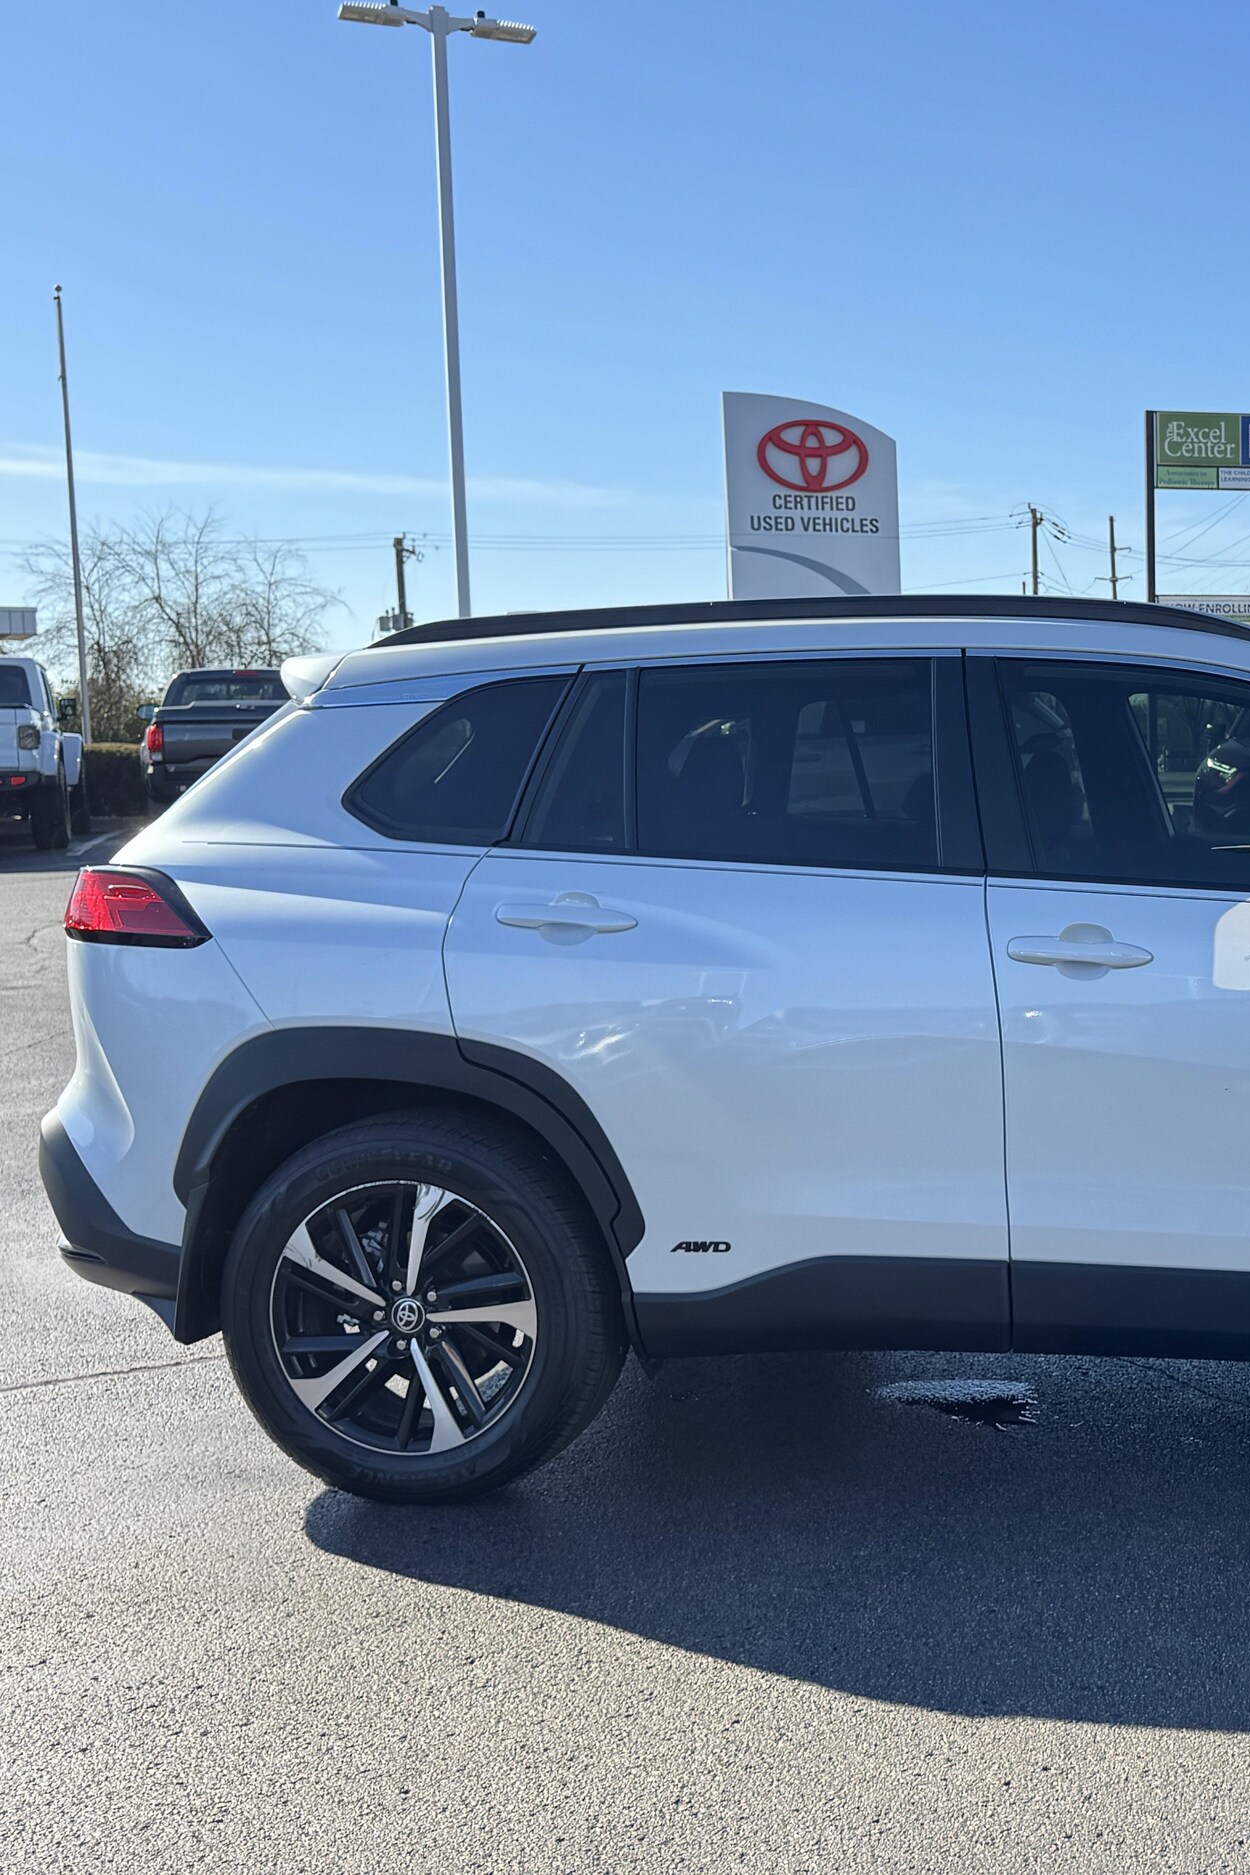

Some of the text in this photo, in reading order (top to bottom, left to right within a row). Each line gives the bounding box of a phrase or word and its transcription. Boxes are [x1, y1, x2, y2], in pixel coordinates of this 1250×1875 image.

[1172, 421, 1227, 443] Excel
[1164, 436, 1236, 458] Center
[772, 494, 856, 512] CERTIFIED
[750, 515, 880, 534] USED VEHICLES
[670, 1241, 731, 1253] AWD
